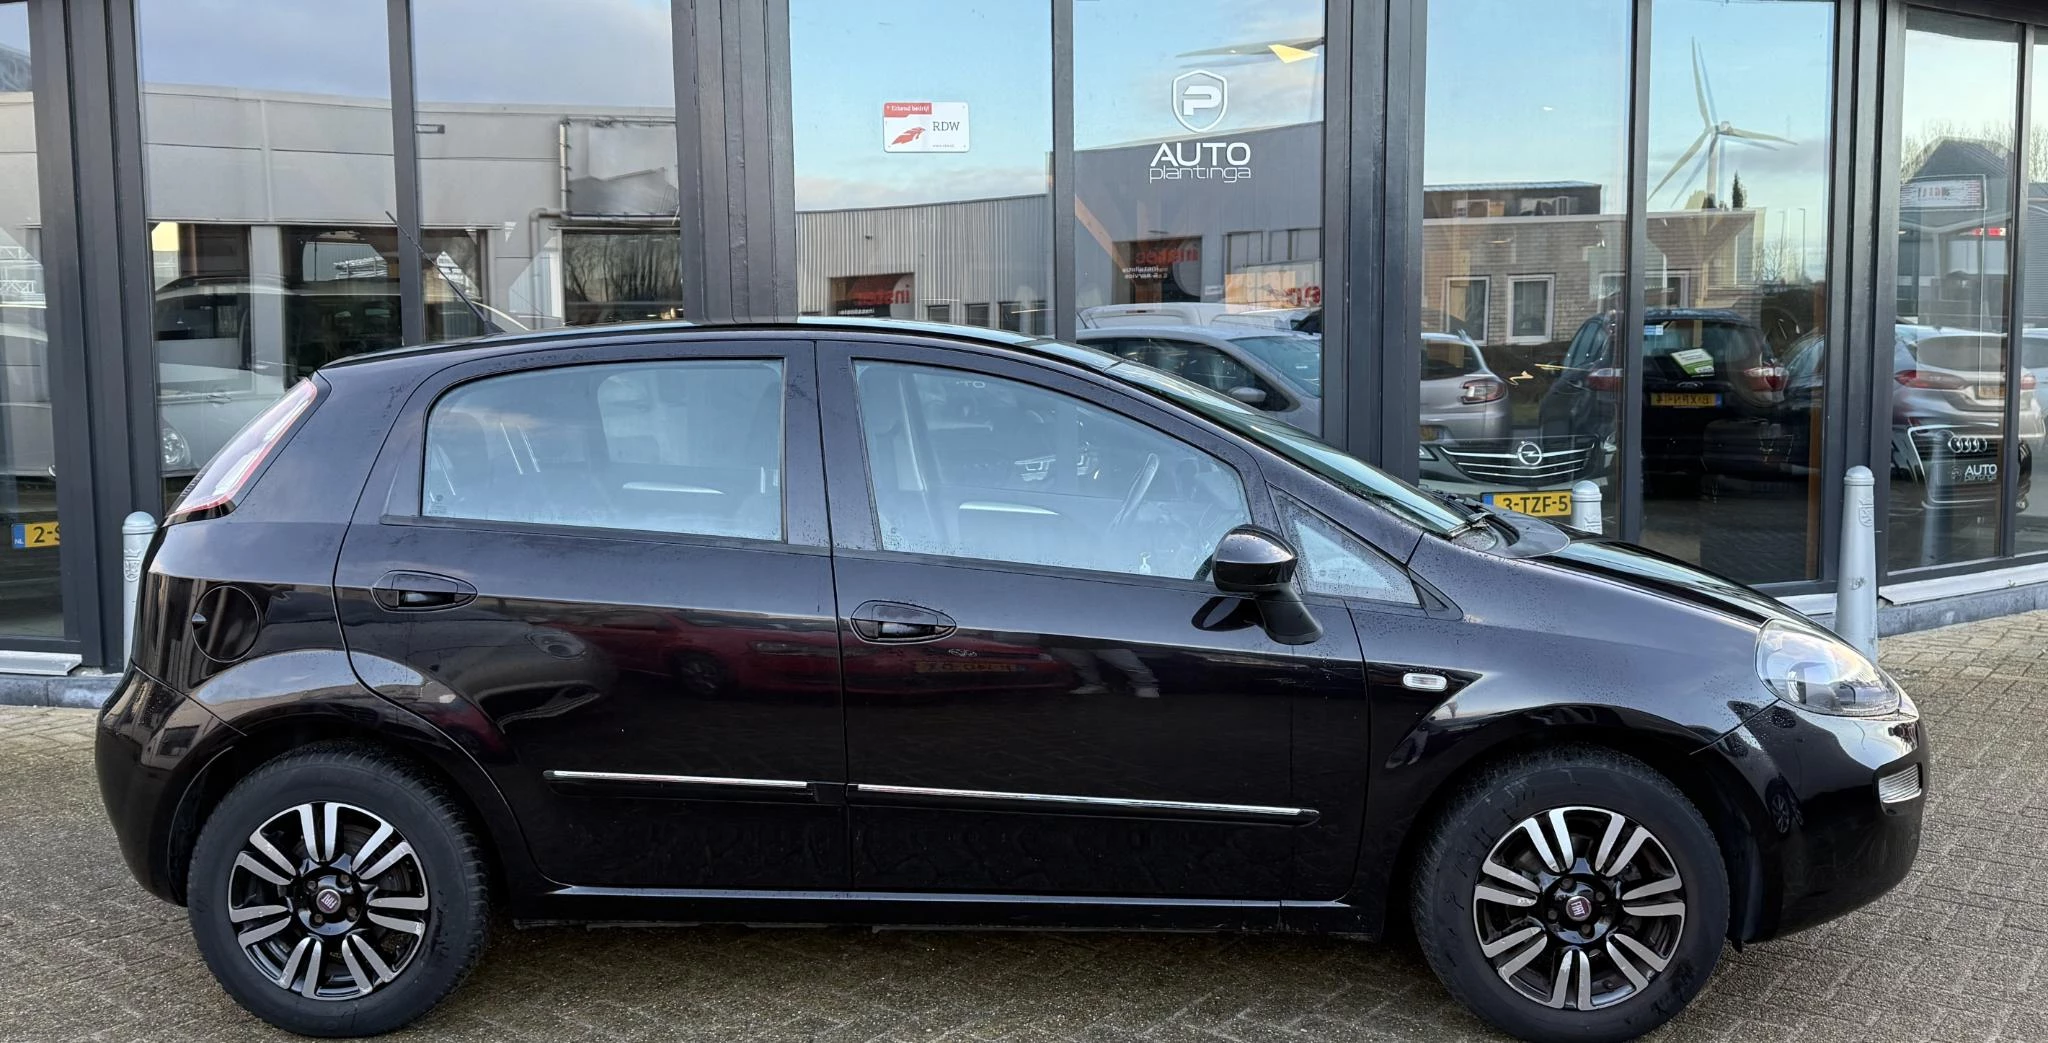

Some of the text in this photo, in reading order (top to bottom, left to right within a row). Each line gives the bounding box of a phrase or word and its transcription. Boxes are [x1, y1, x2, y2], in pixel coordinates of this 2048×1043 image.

[1183, 85, 1222, 116] P
[932, 121, 960, 132] RDW
[1150, 142, 1251, 167] AUTO
[1149, 164, 1251, 184] plantinga
[1964, 463, 1998, 477] AUTO
